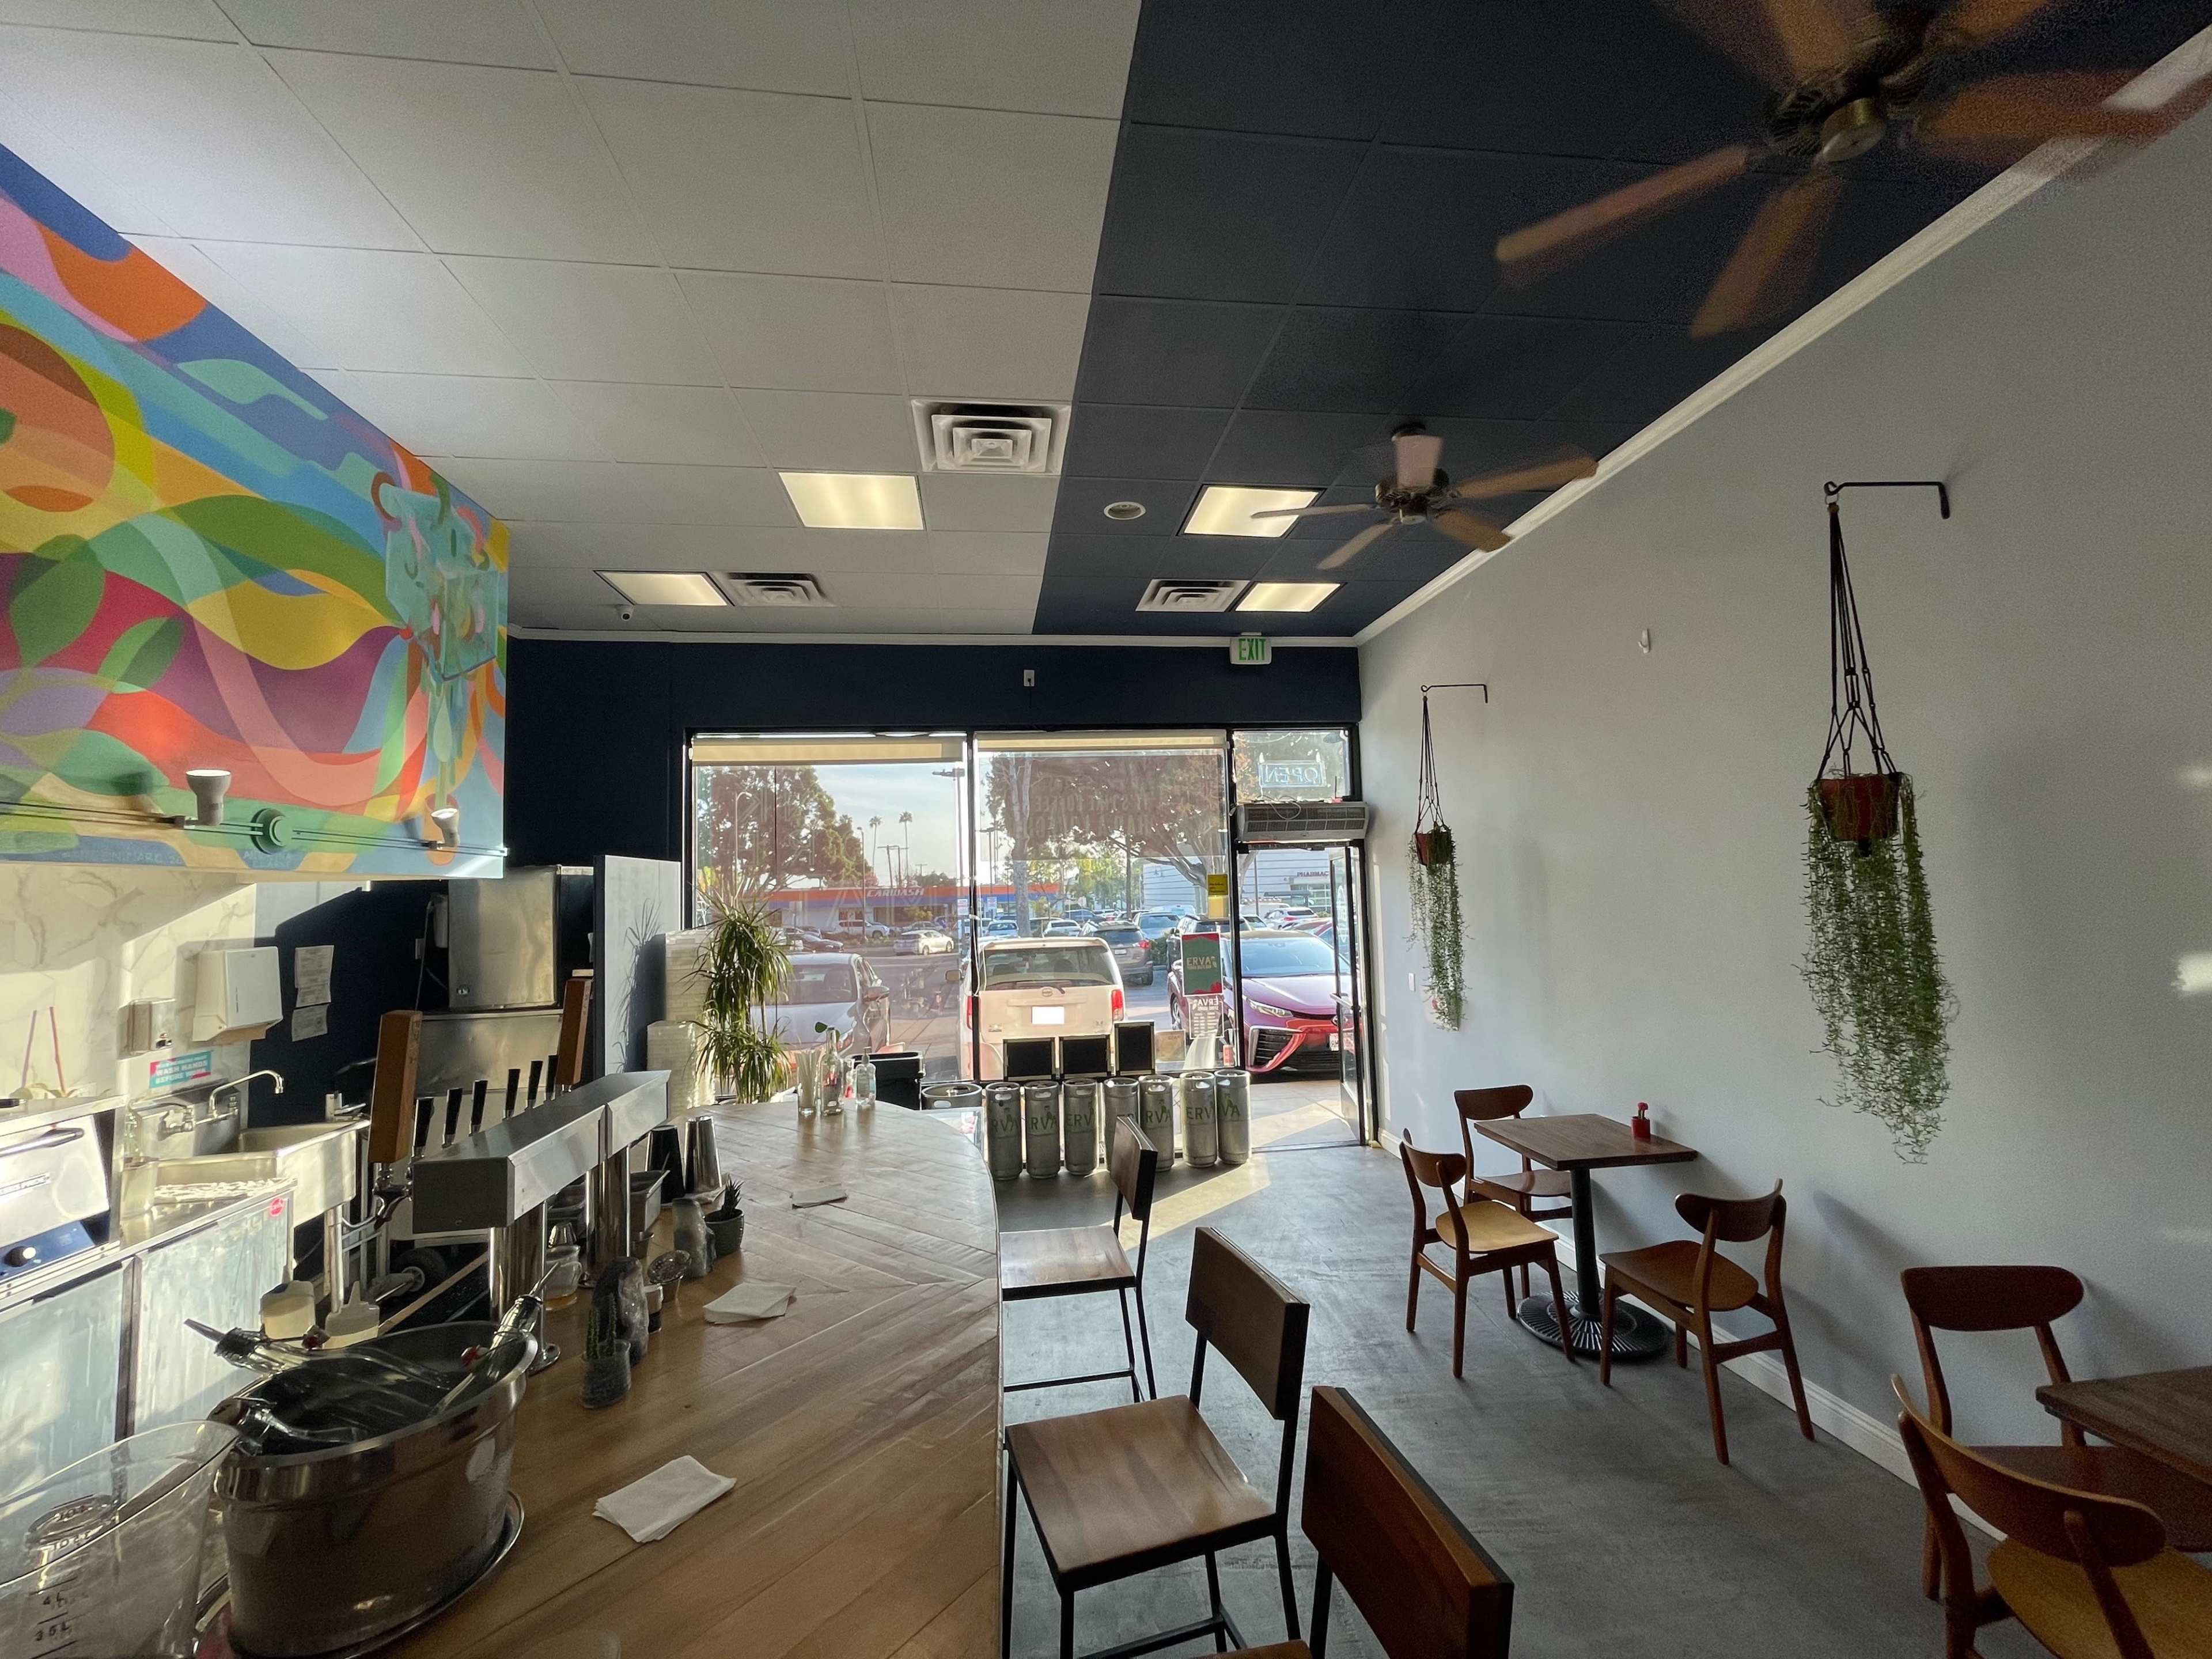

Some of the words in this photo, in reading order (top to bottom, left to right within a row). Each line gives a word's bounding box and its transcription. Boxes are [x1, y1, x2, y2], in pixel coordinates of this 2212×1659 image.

[1238, 638, 1266, 661] EXIT
[866, 888, 925, 897] CARWASH
[1185, 956, 1212, 965] ERVA
[156, 1065, 180, 1075] WASH
[181, 1060, 208, 1071] HANDS
[1146, 1108, 1172, 1123] RVA
[1185, 1106, 1215, 1120] ERV
[1219, 1104, 1241, 1118] VA
[991, 1118, 1019, 1133] RVA
[1028, 1115, 1056, 1130] RVA
[1066, 1113, 1094, 1127] ERV
